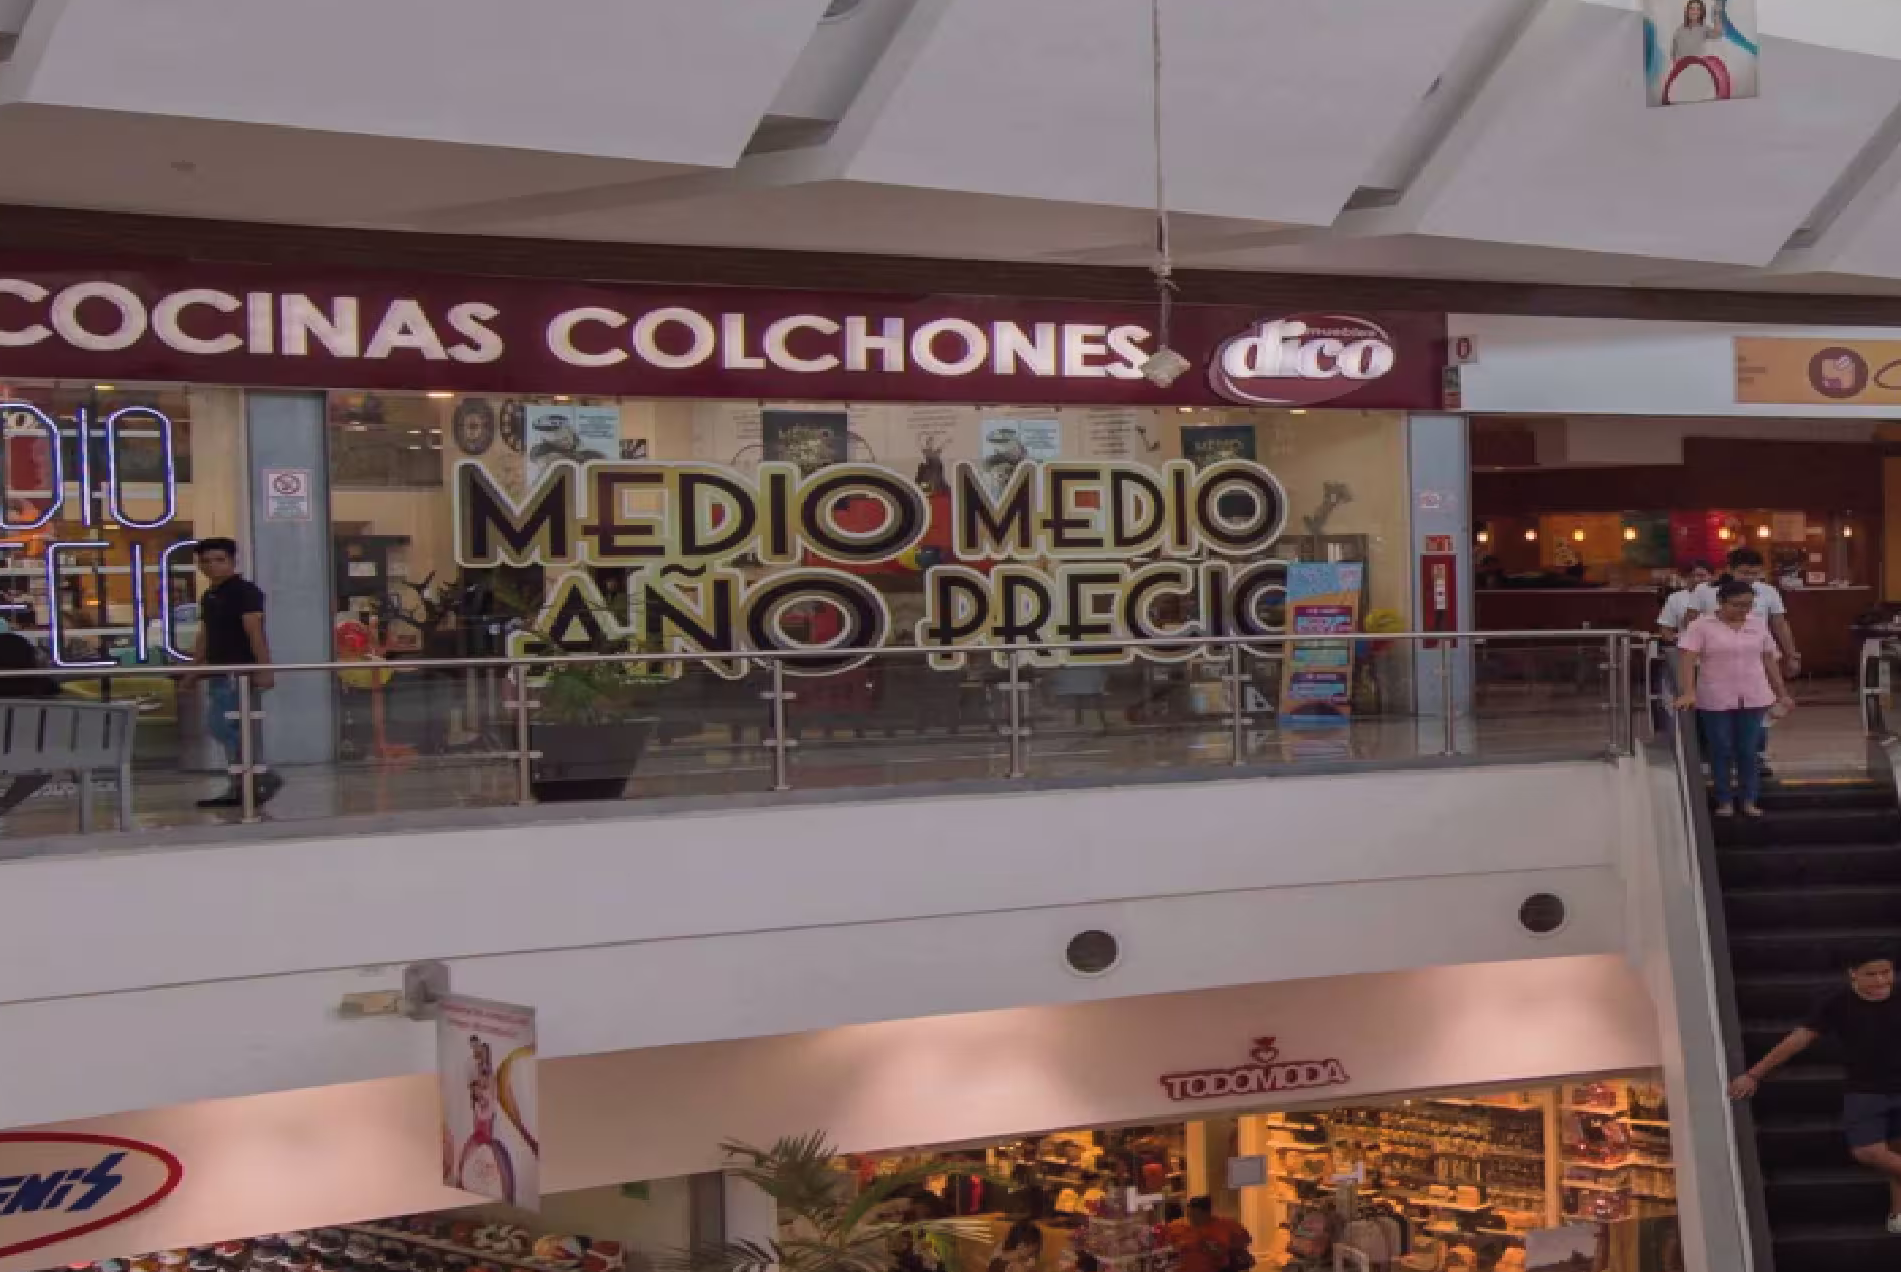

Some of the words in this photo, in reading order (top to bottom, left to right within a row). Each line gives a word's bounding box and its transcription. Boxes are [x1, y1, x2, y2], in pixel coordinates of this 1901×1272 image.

[545, 305, 1153, 380] COLCHONES
[1221, 319, 1395, 379] dico
[455, 459, 927, 567] MEDIO
[954, 459, 1289, 561] MEDIO
[507, 562, 891, 680] AÑO
[1160, 1058, 1351, 1102] TODOMODA
